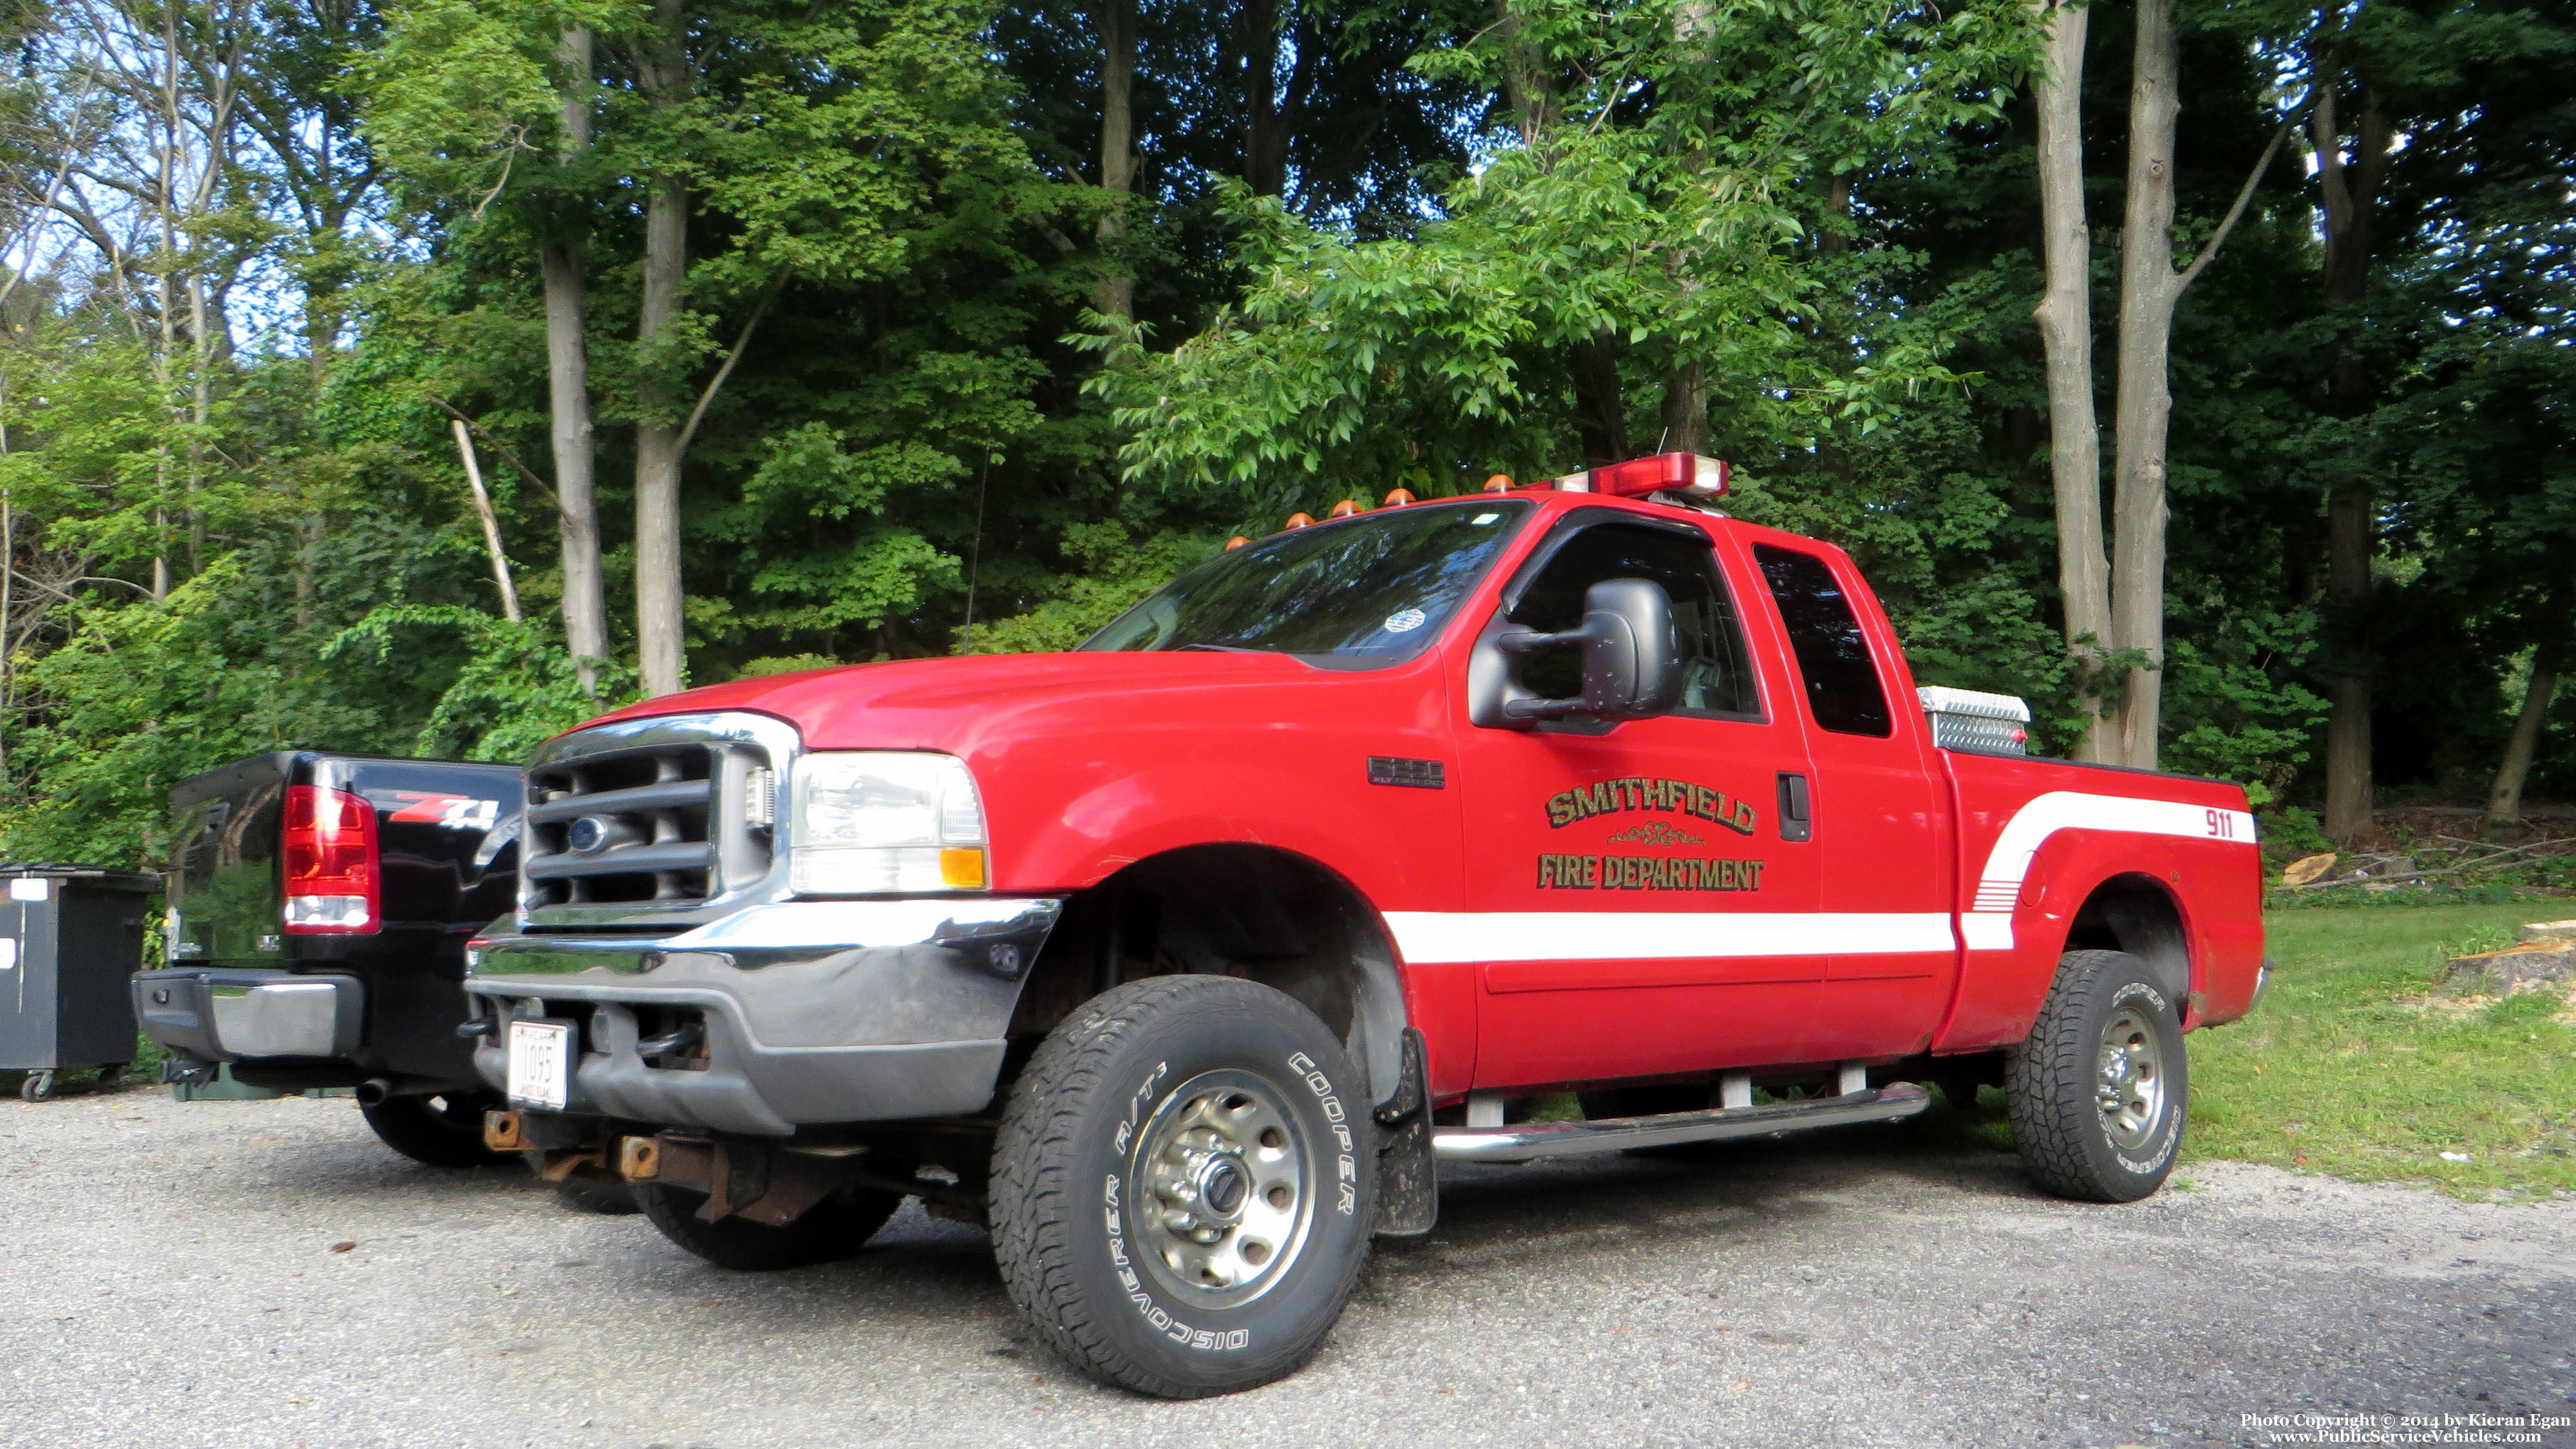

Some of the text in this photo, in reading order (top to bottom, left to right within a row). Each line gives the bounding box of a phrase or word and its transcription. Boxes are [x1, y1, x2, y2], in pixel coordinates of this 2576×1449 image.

[389, 793, 499, 821] Z71
[1546, 777, 1757, 835] SMITHFIELD
[2206, 809, 2233, 838] 911
[1537, 854, 1765, 891] FIRE DEPARTMENT
[2112, 982, 2166, 1012] COOPER
[524, 1043, 553, 1083] 1095
[1289, 1052, 1356, 1215] COOPER
[2117, 1104, 2182, 1174] DISCOVERER
[1104, 1174, 1249, 1350] DISCOVERER
